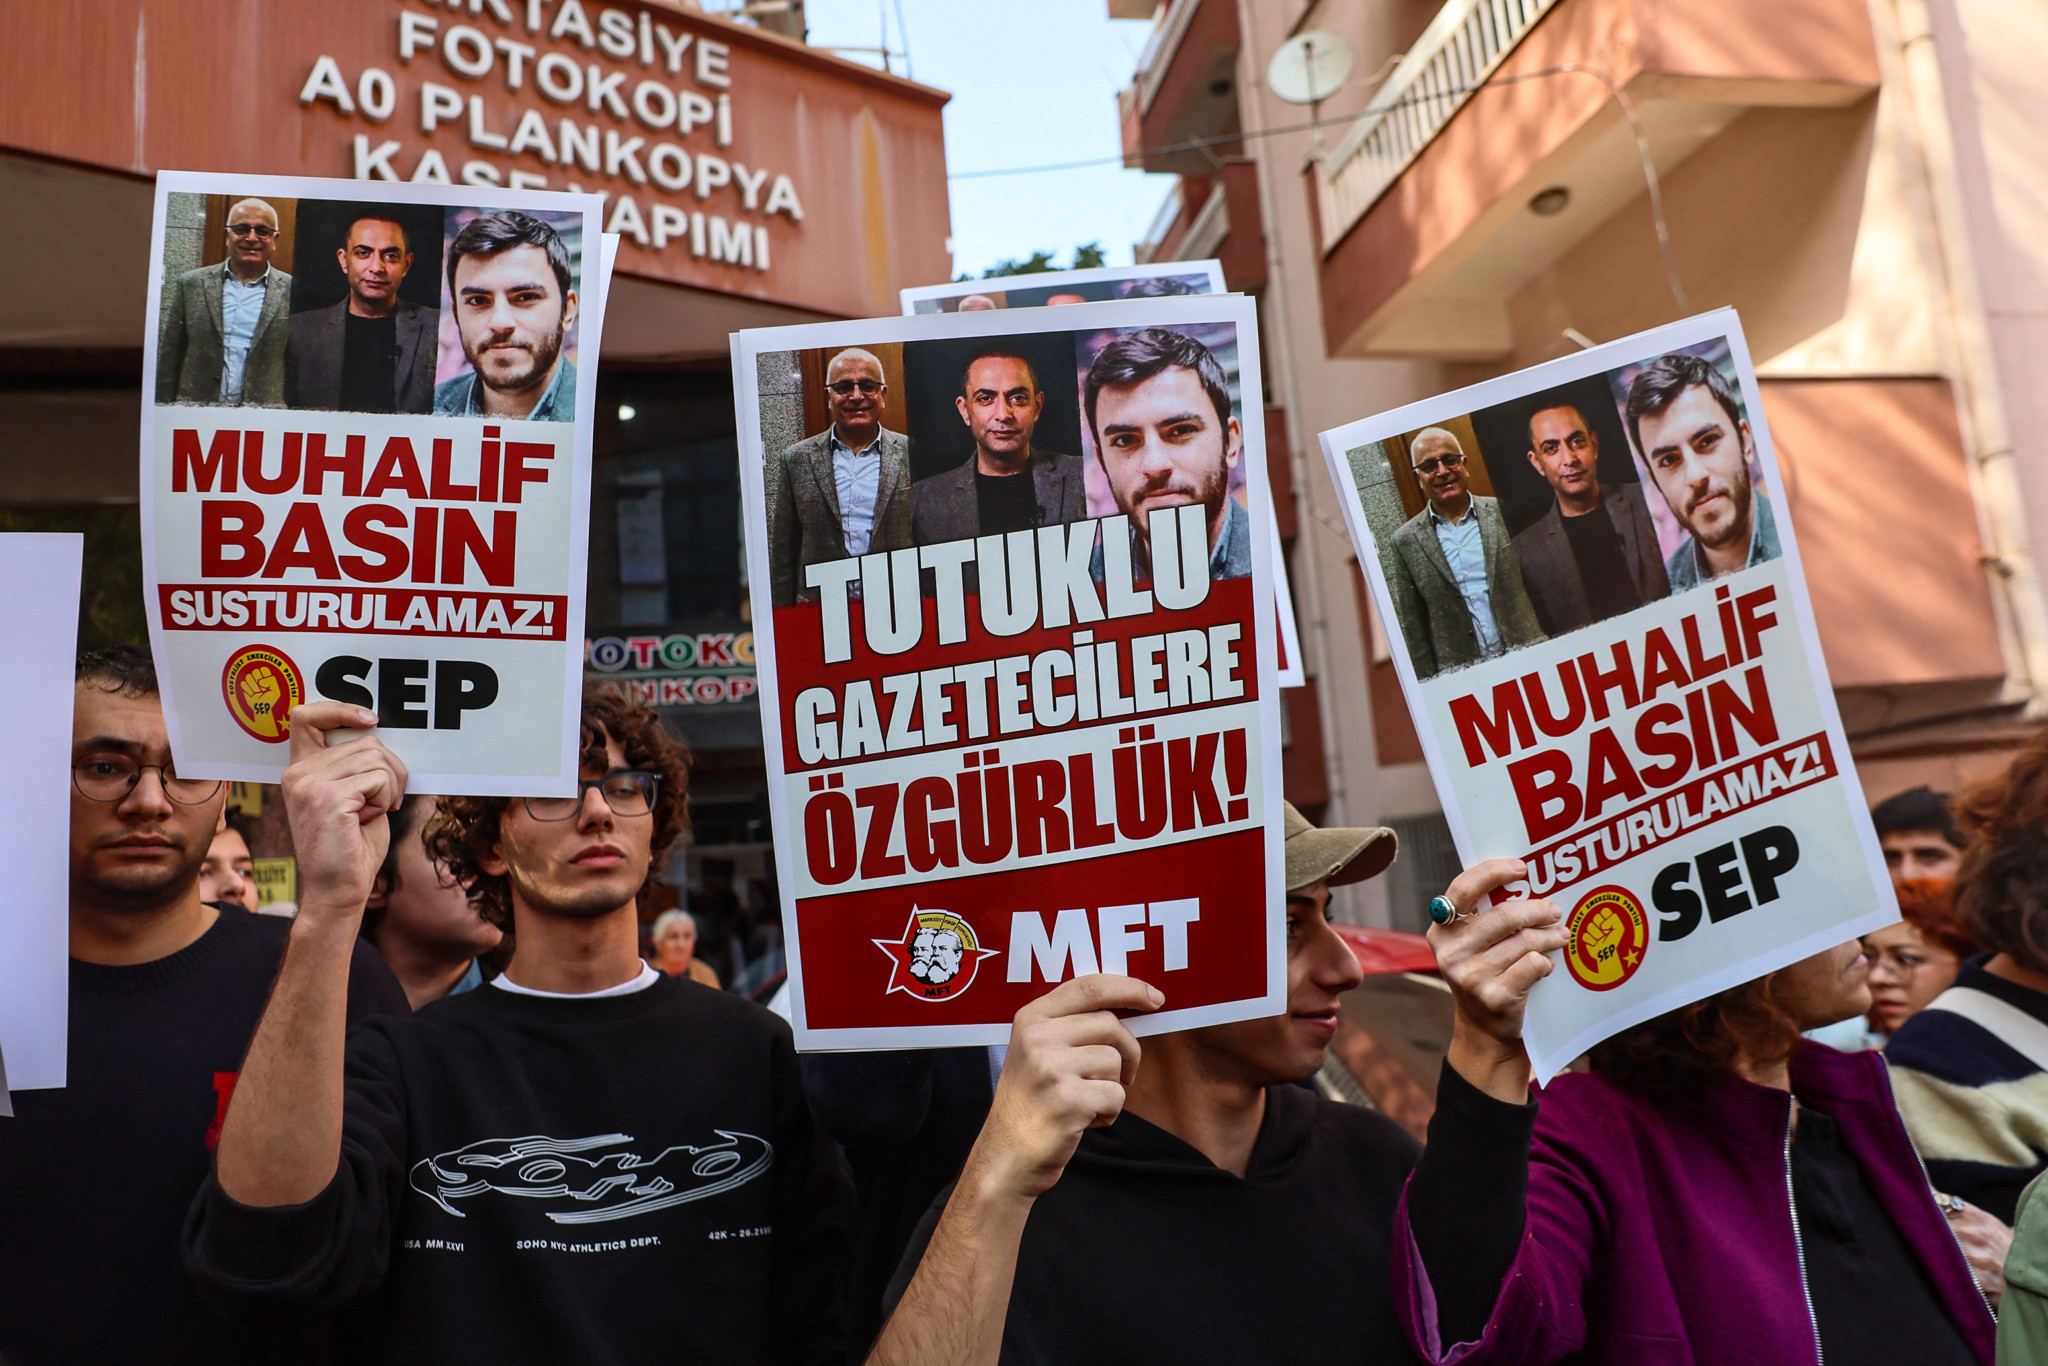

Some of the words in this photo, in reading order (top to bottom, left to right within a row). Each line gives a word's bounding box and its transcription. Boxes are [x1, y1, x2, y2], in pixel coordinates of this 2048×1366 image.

[399, 10, 732, 147] FOTOKOPİ
[425, 0, 732, 89] TASİYE
[421, 81, 804, 222] PLANKOPYA
[569, 183, 770, 271] APIMI
[172, 426, 555, 503] MUHALİF
[201, 500, 517, 587] BASIN
[805, 503, 1212, 664] TUTUKLU
[171, 590, 554, 636] SUSTURULAMAZ!
[585, 633, 757, 671] OTOKO
[253, 702, 271, 715] SEP
[316, 655, 499, 730] SEP
[795, 622, 1245, 765] GAZETECİLERE
[1448, 584, 1778, 768] MUHALİF
[1506, 664, 1780, 846] BASIN
[804, 723, 1249, 886] ÖZGÜRLÜK!
[1651, 825, 1800, 942] SEP
[1006, 897, 1200, 983] MFT
[1597, 943, 1616, 963] SEP
[924, 985, 951, 997] MFT
[404, 1240, 421, 1249] USA
[516, 1240, 548, 1249] SOHO
[550, 1240, 567, 1252] NYC
[569, 1240, 627, 1253] ATHLETICS
[630, 1236, 661, 1248] DEPT.
